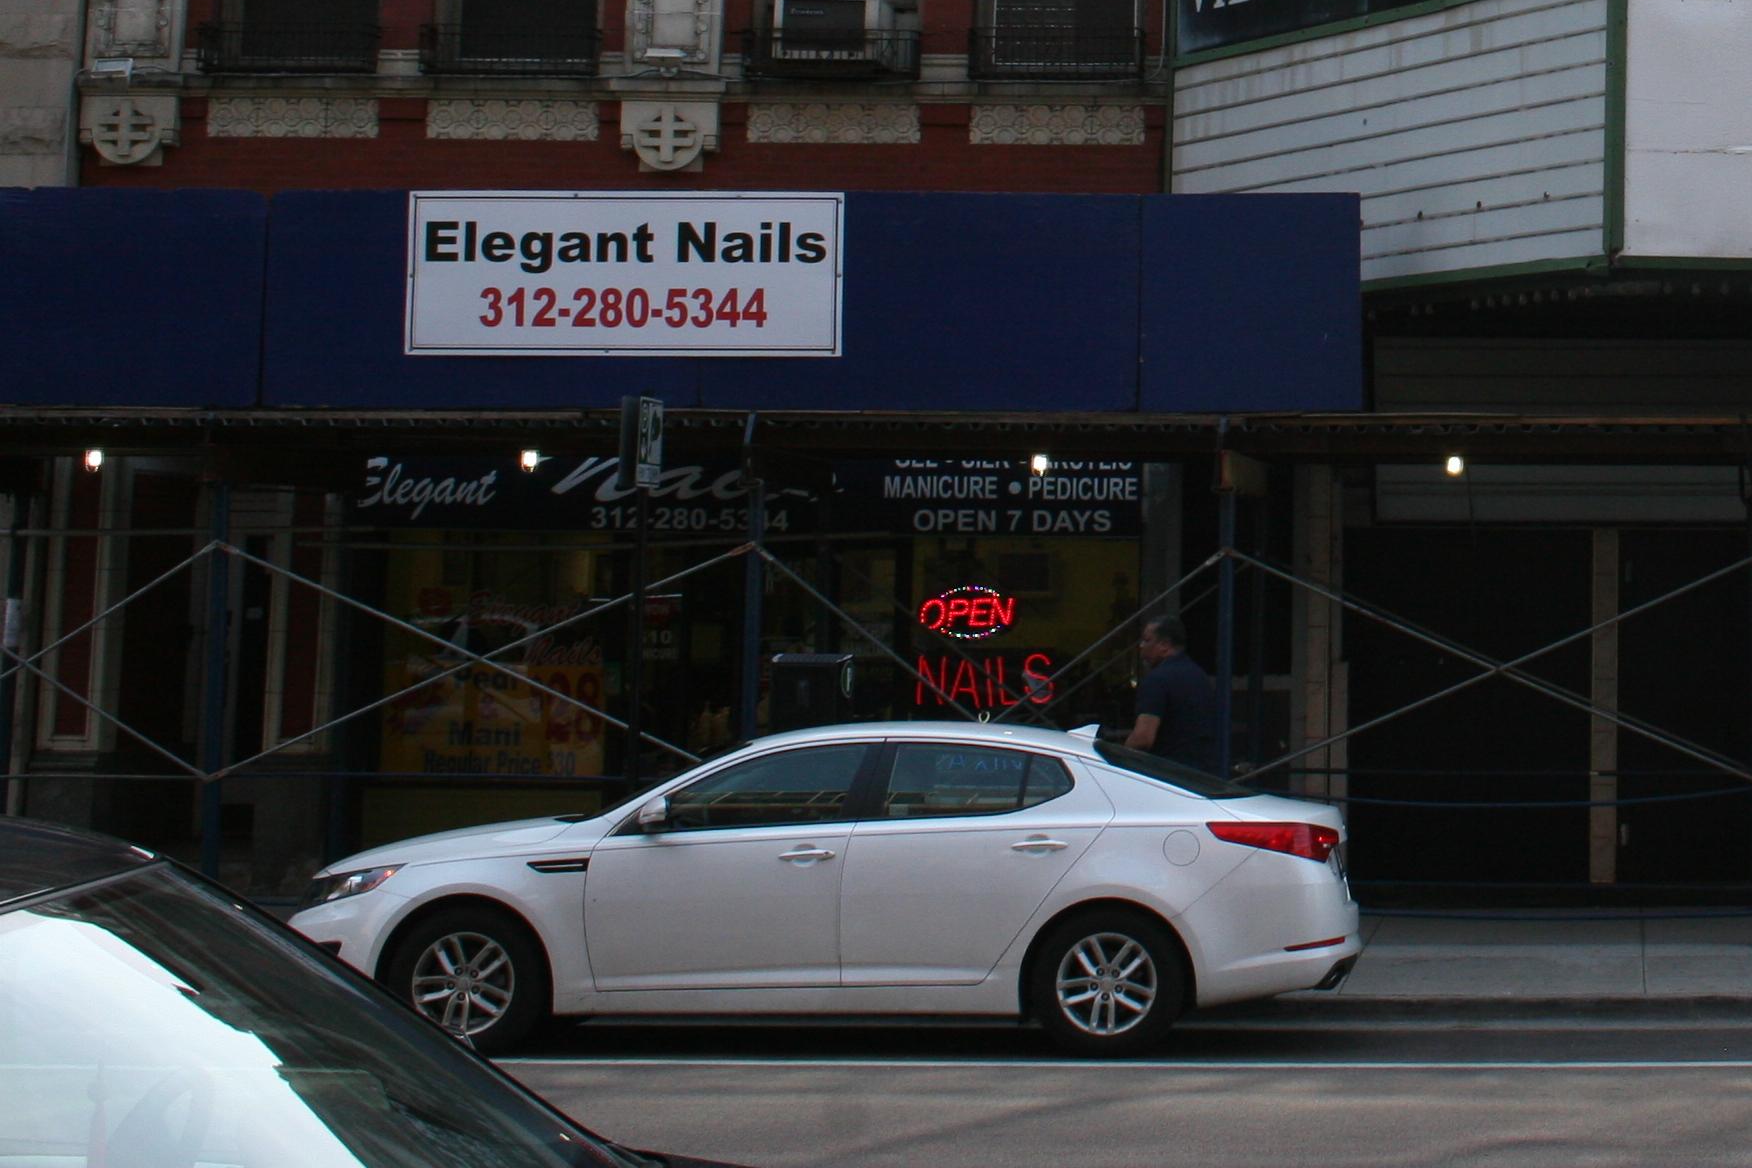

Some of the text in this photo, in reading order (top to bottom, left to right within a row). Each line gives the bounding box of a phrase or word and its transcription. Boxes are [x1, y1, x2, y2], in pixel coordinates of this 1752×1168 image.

[424, 220, 827, 274] Elegant Nails
[479, 287, 768, 328] 312-280-5344
[357, 456, 498, 520] Elegant
[883, 475, 1139, 501] MANICURE PEDICURE
[913, 509, 1113, 533] OPEN 7 DAYS
[917, 596, 1018, 633] OPEN
[914, 652, 1056, 709] NAILS
